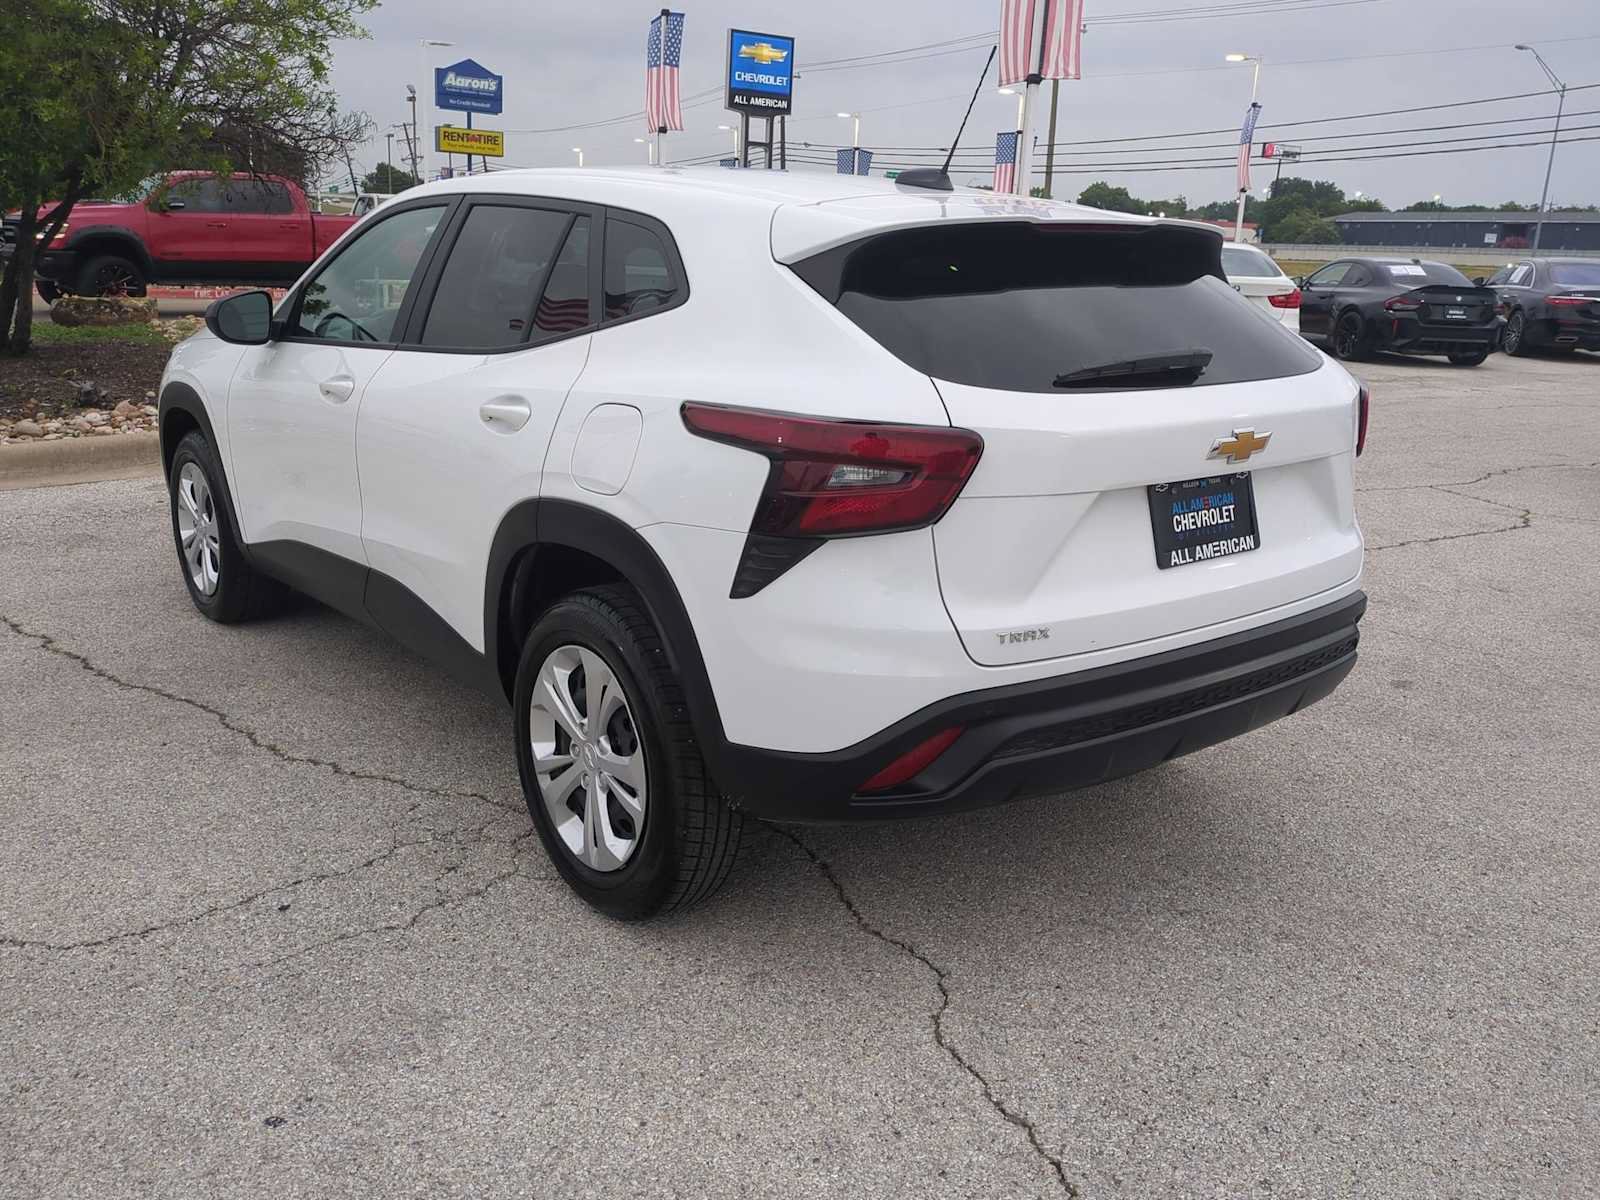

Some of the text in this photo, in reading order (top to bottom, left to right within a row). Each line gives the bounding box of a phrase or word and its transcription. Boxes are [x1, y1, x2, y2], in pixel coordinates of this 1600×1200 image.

[445, 72, 497, 91] Aaron's
[735, 71, 788, 86] CHEVROLET
[734, 95, 788, 109] ALL AMERICAN
[1172, 500, 1191, 514] ALL
[1173, 504, 1236, 533] CHEVROLET
[1170, 535, 1255, 566] ALL AMERICAN
[996, 627, 1050, 644] TRAX
